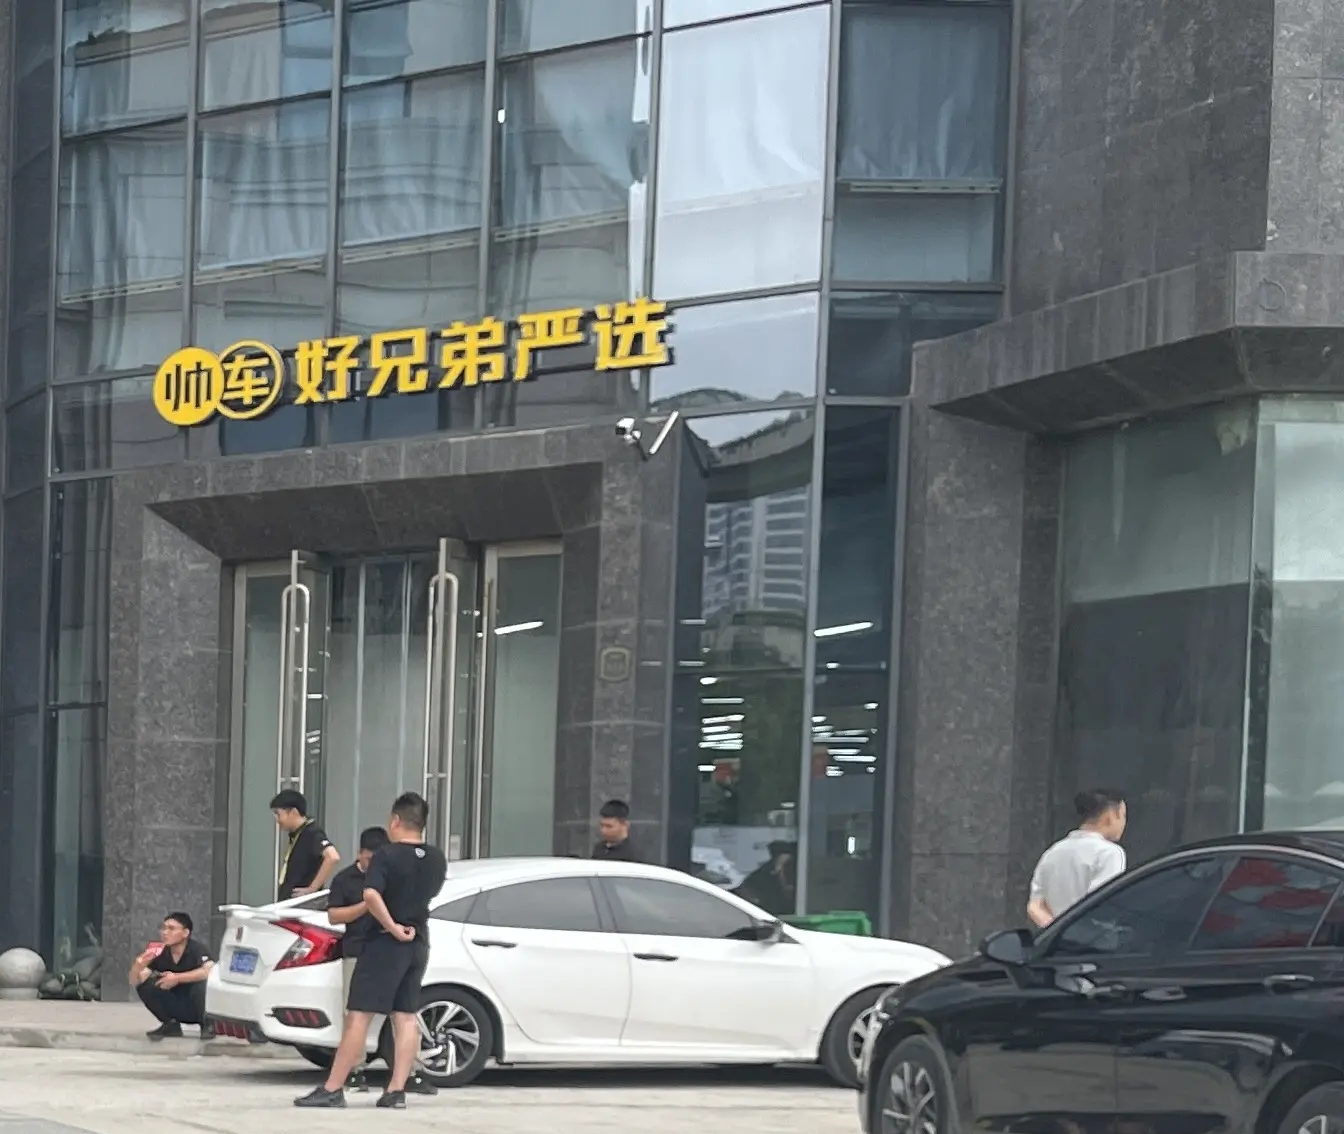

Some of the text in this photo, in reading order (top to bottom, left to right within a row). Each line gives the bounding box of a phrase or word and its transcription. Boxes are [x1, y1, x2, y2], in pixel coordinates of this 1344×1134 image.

[159, 297, 669, 417] 帅车 好兄弟严选
